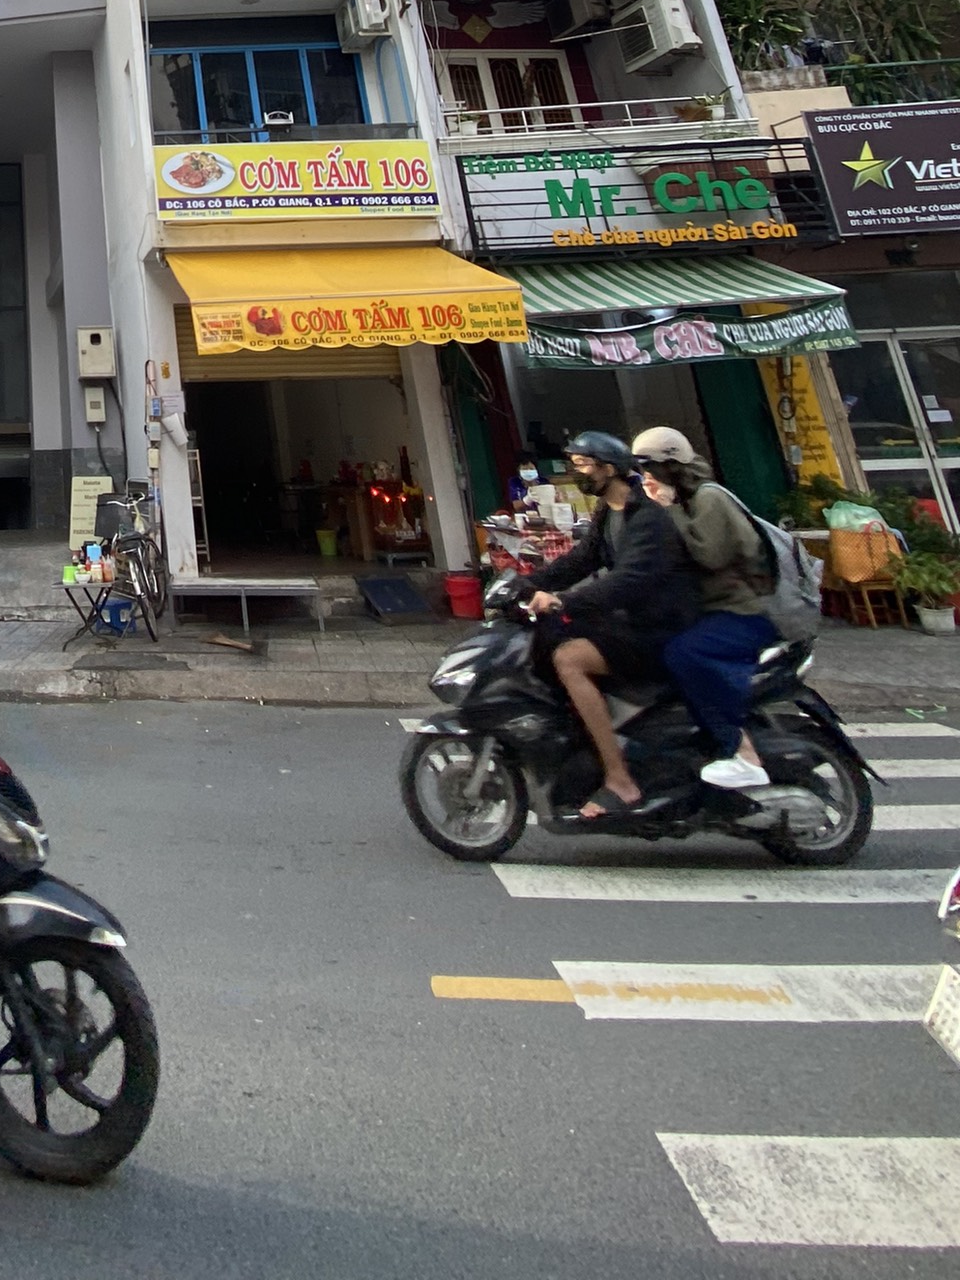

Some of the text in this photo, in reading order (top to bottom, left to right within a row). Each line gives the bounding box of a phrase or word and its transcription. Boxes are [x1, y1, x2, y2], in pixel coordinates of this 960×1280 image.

[817, 124, 838, 133] BƯU
[839, 123, 858, 134] CỤC
[858, 121, 873, 131] CÔ
[239, 146, 430, 191] CƠM TẤM 106
[462, 155, 518, 179] Tiệm
[186, 200, 205, 209] 106
[208, 197, 222, 208] CÔ
[252, 195, 277, 207] P.CÔ
[279, 197, 312, 208] GIANG,
[315, 197, 332, 207] Q.1
[341, 196, 359, 206] ĐT:
[361, 196, 389, 205] 0902
[390, 195, 411, 205] 666
[413, 195, 434, 204] 634
[544, 166, 770, 218] Mr. Chè
[891, 206, 903, 215] CÔ
[928, 204, 940, 212] CÔ
[552, 218, 798, 247] Chè của người Sài Gòn
[291, 299, 463, 333] CƠM TẤM 106
[293, 336, 308, 345] CÔ
[460, 331, 484, 339] 0902
